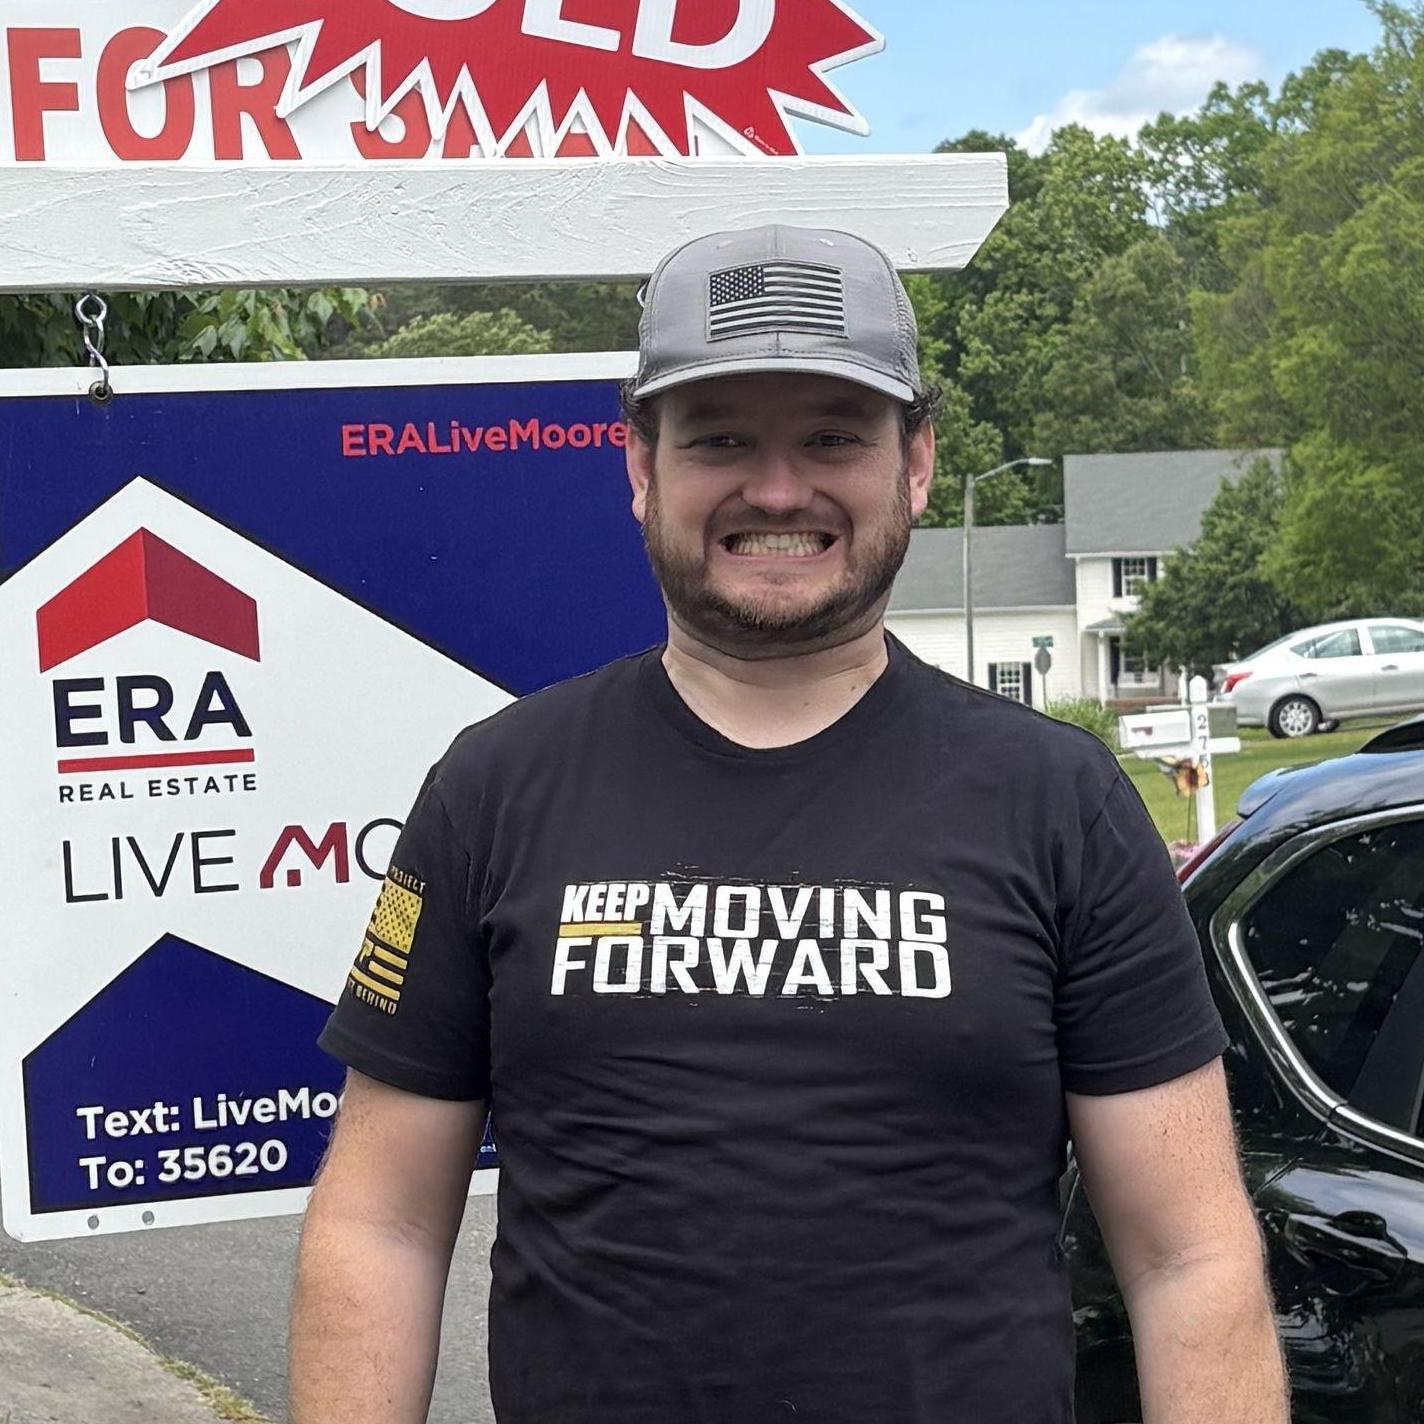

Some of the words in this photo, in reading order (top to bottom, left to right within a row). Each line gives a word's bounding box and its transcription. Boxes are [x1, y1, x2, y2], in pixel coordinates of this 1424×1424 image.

[6, 27, 302, 161] FOR
[341, 418, 626, 456] ERALiveMoore
[52, 671, 252, 747] ERA
[59, 782, 134, 804] REAL
[148, 774, 257, 798] ESTATE
[62, 829, 240, 904] LIVE
[561, 883, 650, 923] KEEP
[650, 882, 948, 943] MOVING
[550, 937, 952, 1000] FORWARD
[76, 1101, 180, 1140] Text:
[79, 1156, 145, 1190] To:
[157, 1139, 288, 1183] 35620
